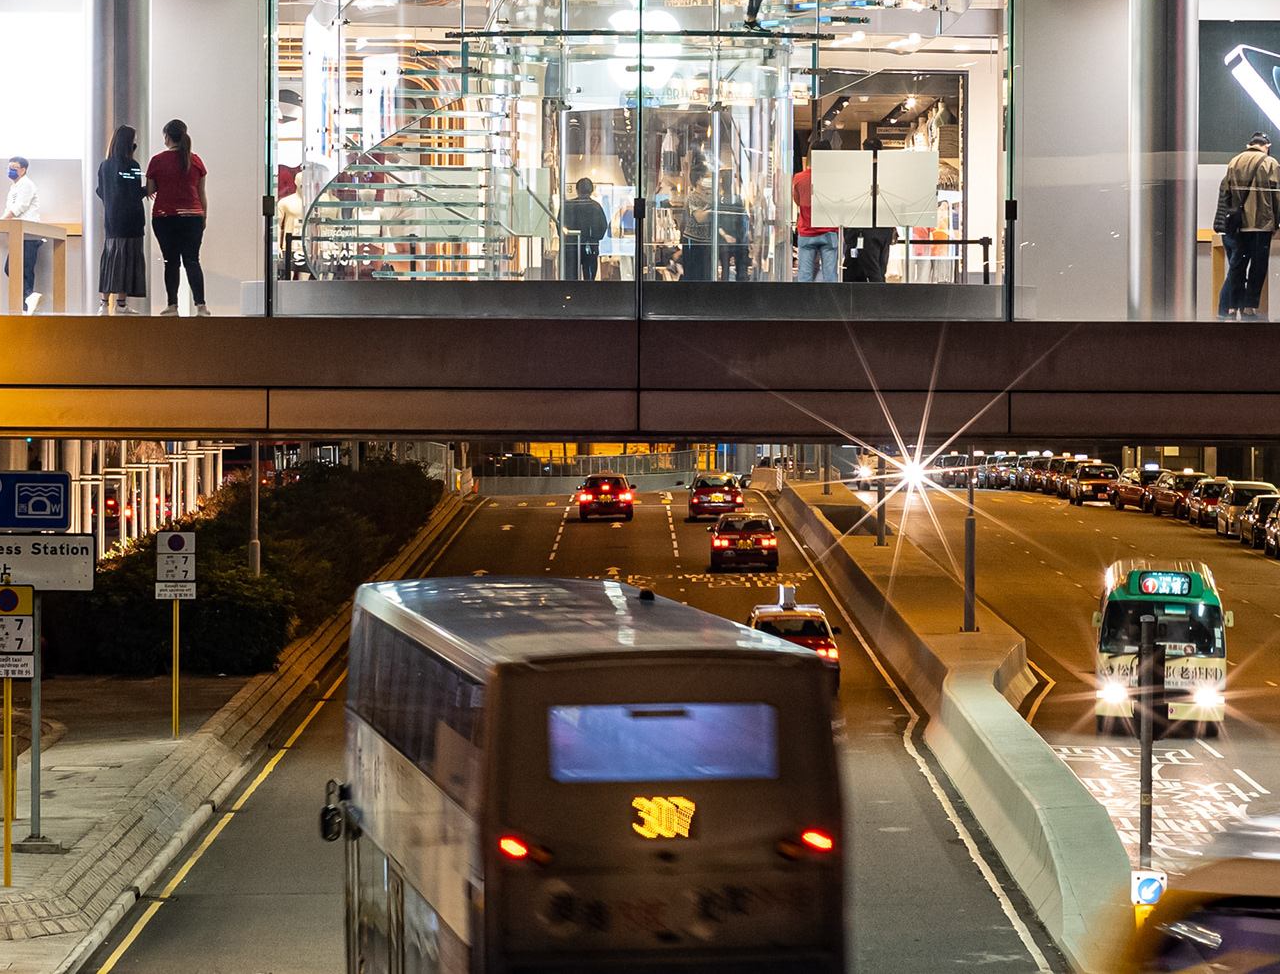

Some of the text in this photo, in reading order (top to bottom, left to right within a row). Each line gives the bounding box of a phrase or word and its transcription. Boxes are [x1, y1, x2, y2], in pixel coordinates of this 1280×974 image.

[51, 504, 61, 514] W
[31, 542, 90, 556] Station
[182, 556, 189, 565] 7
[182, 570, 189, 579] 7
[15, 619, 23, 631] 7
[15, 638, 23, 650] 7
[631, 796, 696, 838] 307
